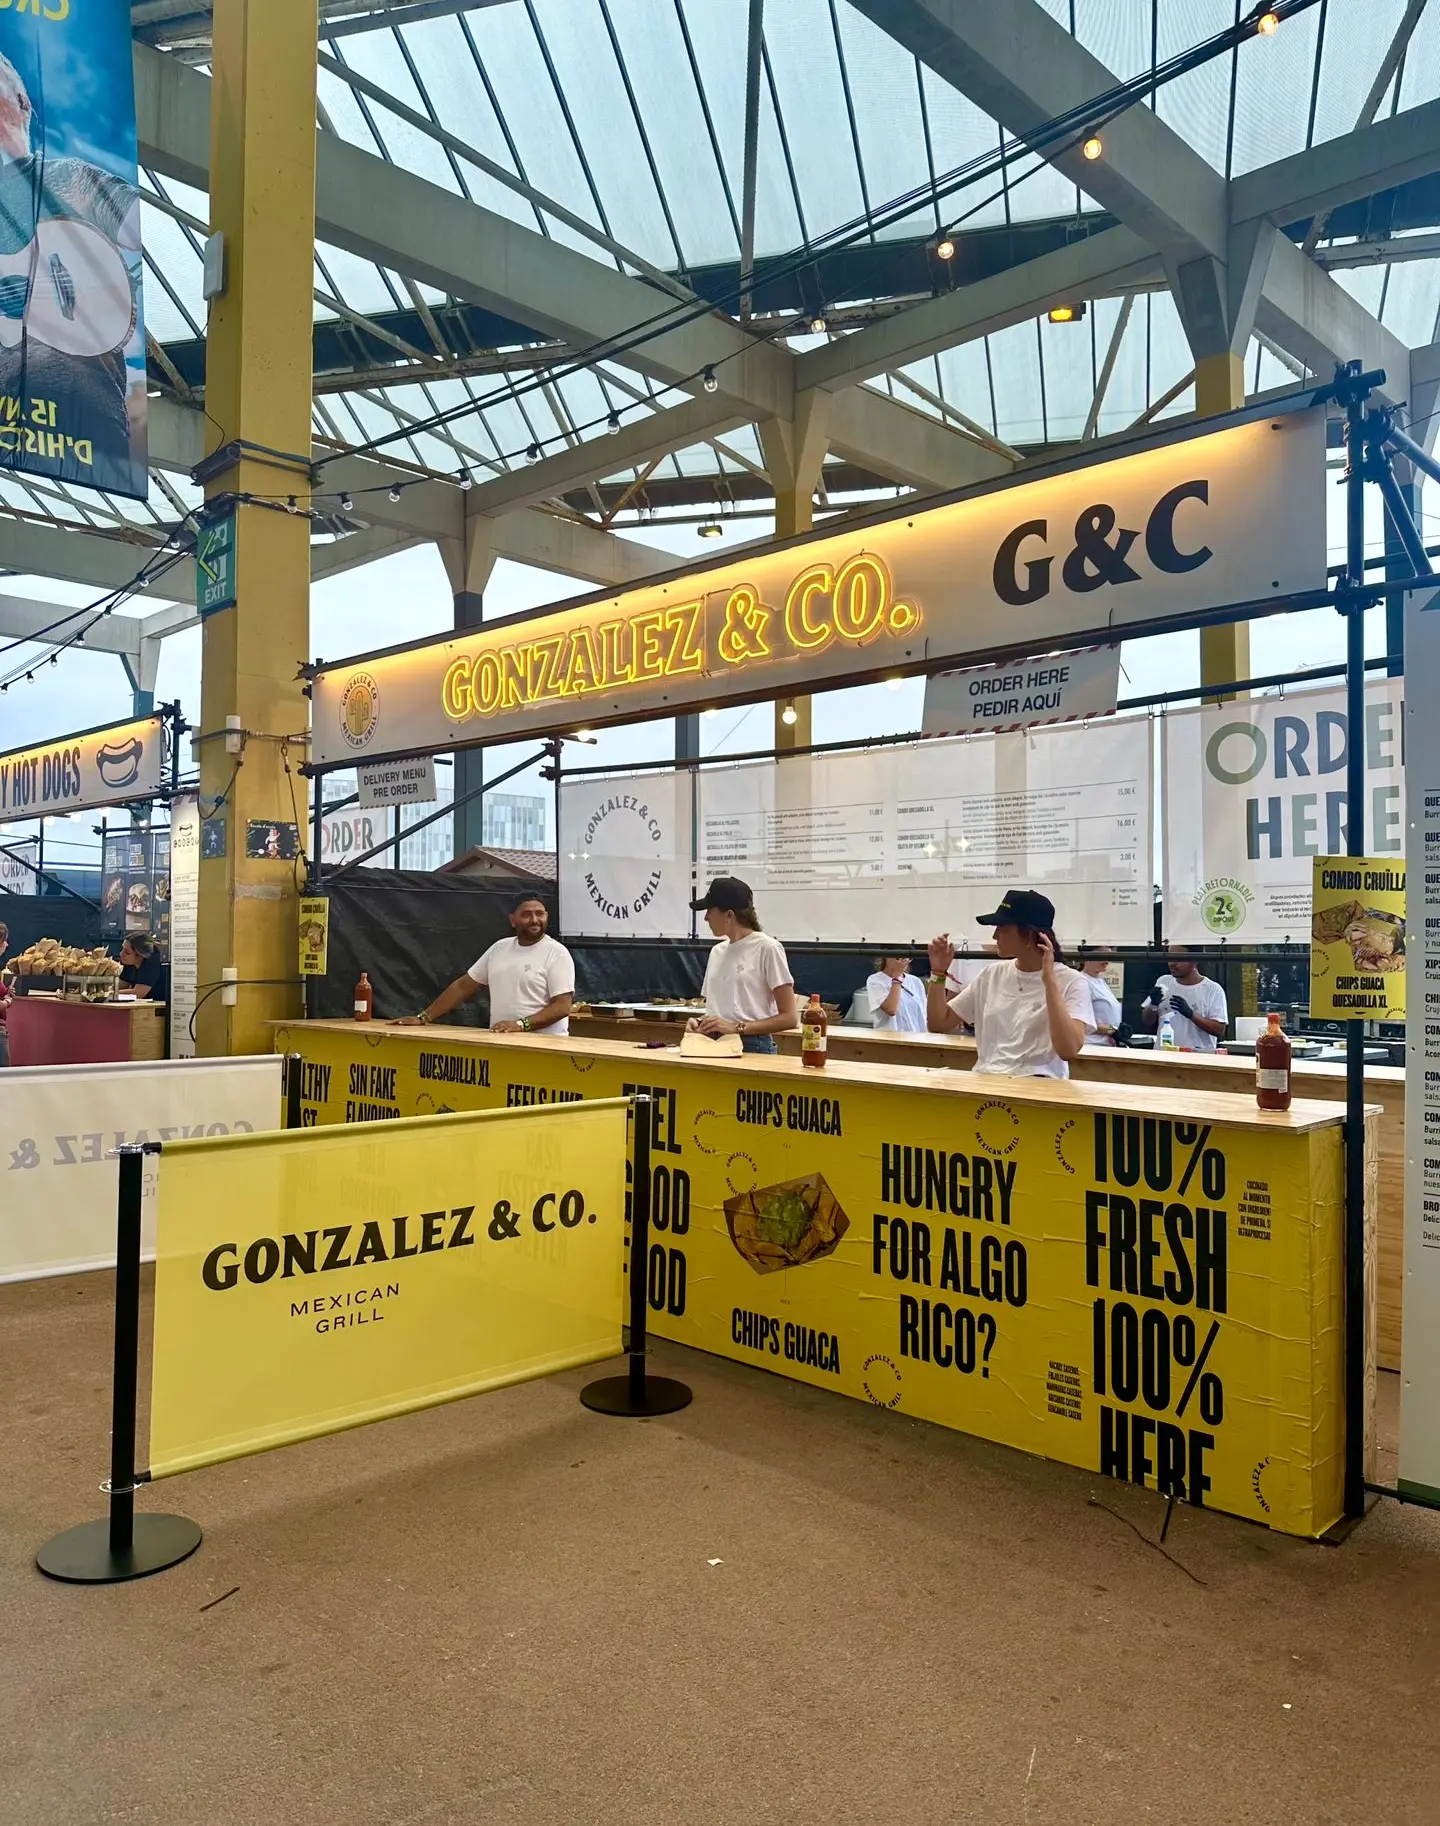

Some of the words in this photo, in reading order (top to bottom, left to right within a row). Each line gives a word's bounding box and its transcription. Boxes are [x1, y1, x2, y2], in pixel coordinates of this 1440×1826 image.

[992, 479, 1213, 606] G&C
[205, 583, 226, 604] EXIT
[441, 601, 703, 720] GONZALEZ
[717, 588, 769, 663] &
[784, 556, 914, 649] CO.
[968, 673, 1023, 697] ORDER
[1026, 666, 1070, 690] HERE
[972, 698, 1021, 719] PEDIR
[1022, 687, 1062, 713] AQUÍ
[1205, 700, 1406, 786] ORDE
[12, 756, 39, 807] HOT
[42, 746, 81, 802] DOGS
[363, 771, 401, 786] DELIVERY
[402, 767, 427, 780] MENU
[373, 786, 389, 799] PRE
[390, 782, 419, 797] ORDER
[584, 795, 639, 845] GONZALEZ
[638, 804, 648, 820] &
[647, 819, 662, 842] CO
[584, 872, 630, 919] MEXICAN
[633, 870, 662, 914] GRILL
[1321, 869, 1362, 891] COMBO
[1332, 993, 1377, 1008] QUESADILLA
[1378, 995, 1388, 1009] XL
[1336, 975, 1359, 990] CHIPS
[1359, 976, 1385, 991] GUACA
[349, 1063, 367, 1097] SIN
[370, 1065, 397, 1101] FAKE
[419, 1052, 477, 1086] QUESADILLA
[477, 1059, 491, 1088] XL
[736, 1088, 783, 1128] CHIPS
[787, 1093, 842, 1137] GUACA
[975, 1100, 1006, 1120] GONZALEZ
[1011, 1114, 1020, 1125] CO
[974, 1131, 1002, 1156] MEXICAN
[1004, 1136, 1020, 1155] GRILL
[1054, 1133, 1076, 1175] GONZALEZ
[1065, 1119, 1075, 1129] CO
[881, 1142, 1018, 1226] HUNGRY
[1423, 1200, 1439, 1212] BRO
[202, 1205, 476, 1292] GONZALEZ
[487, 1198, 522, 1242] &
[532, 1188, 598, 1234] CO.
[1085, 1189, 1228, 1314] FRESH
[873, 1213, 932, 1287] FOR
[940, 1226, 1028, 1308] ALGO
[290, 1282, 401, 1318] MEXICAN
[315, 1310, 385, 1335] GRILL
[731, 1307, 780, 1356] CHIPS
[784, 1321, 841, 1375] GUACA
[900, 1293, 998, 1379] RICO?
[862, 1354, 890, 1371] GONZALEZ
[894, 1370, 902, 1381] CO
[1093, 1297, 1224, 1426] 100%
[889, 1392, 902, 1408] GRILL
[1100, 1404, 1215, 1509] HERE
